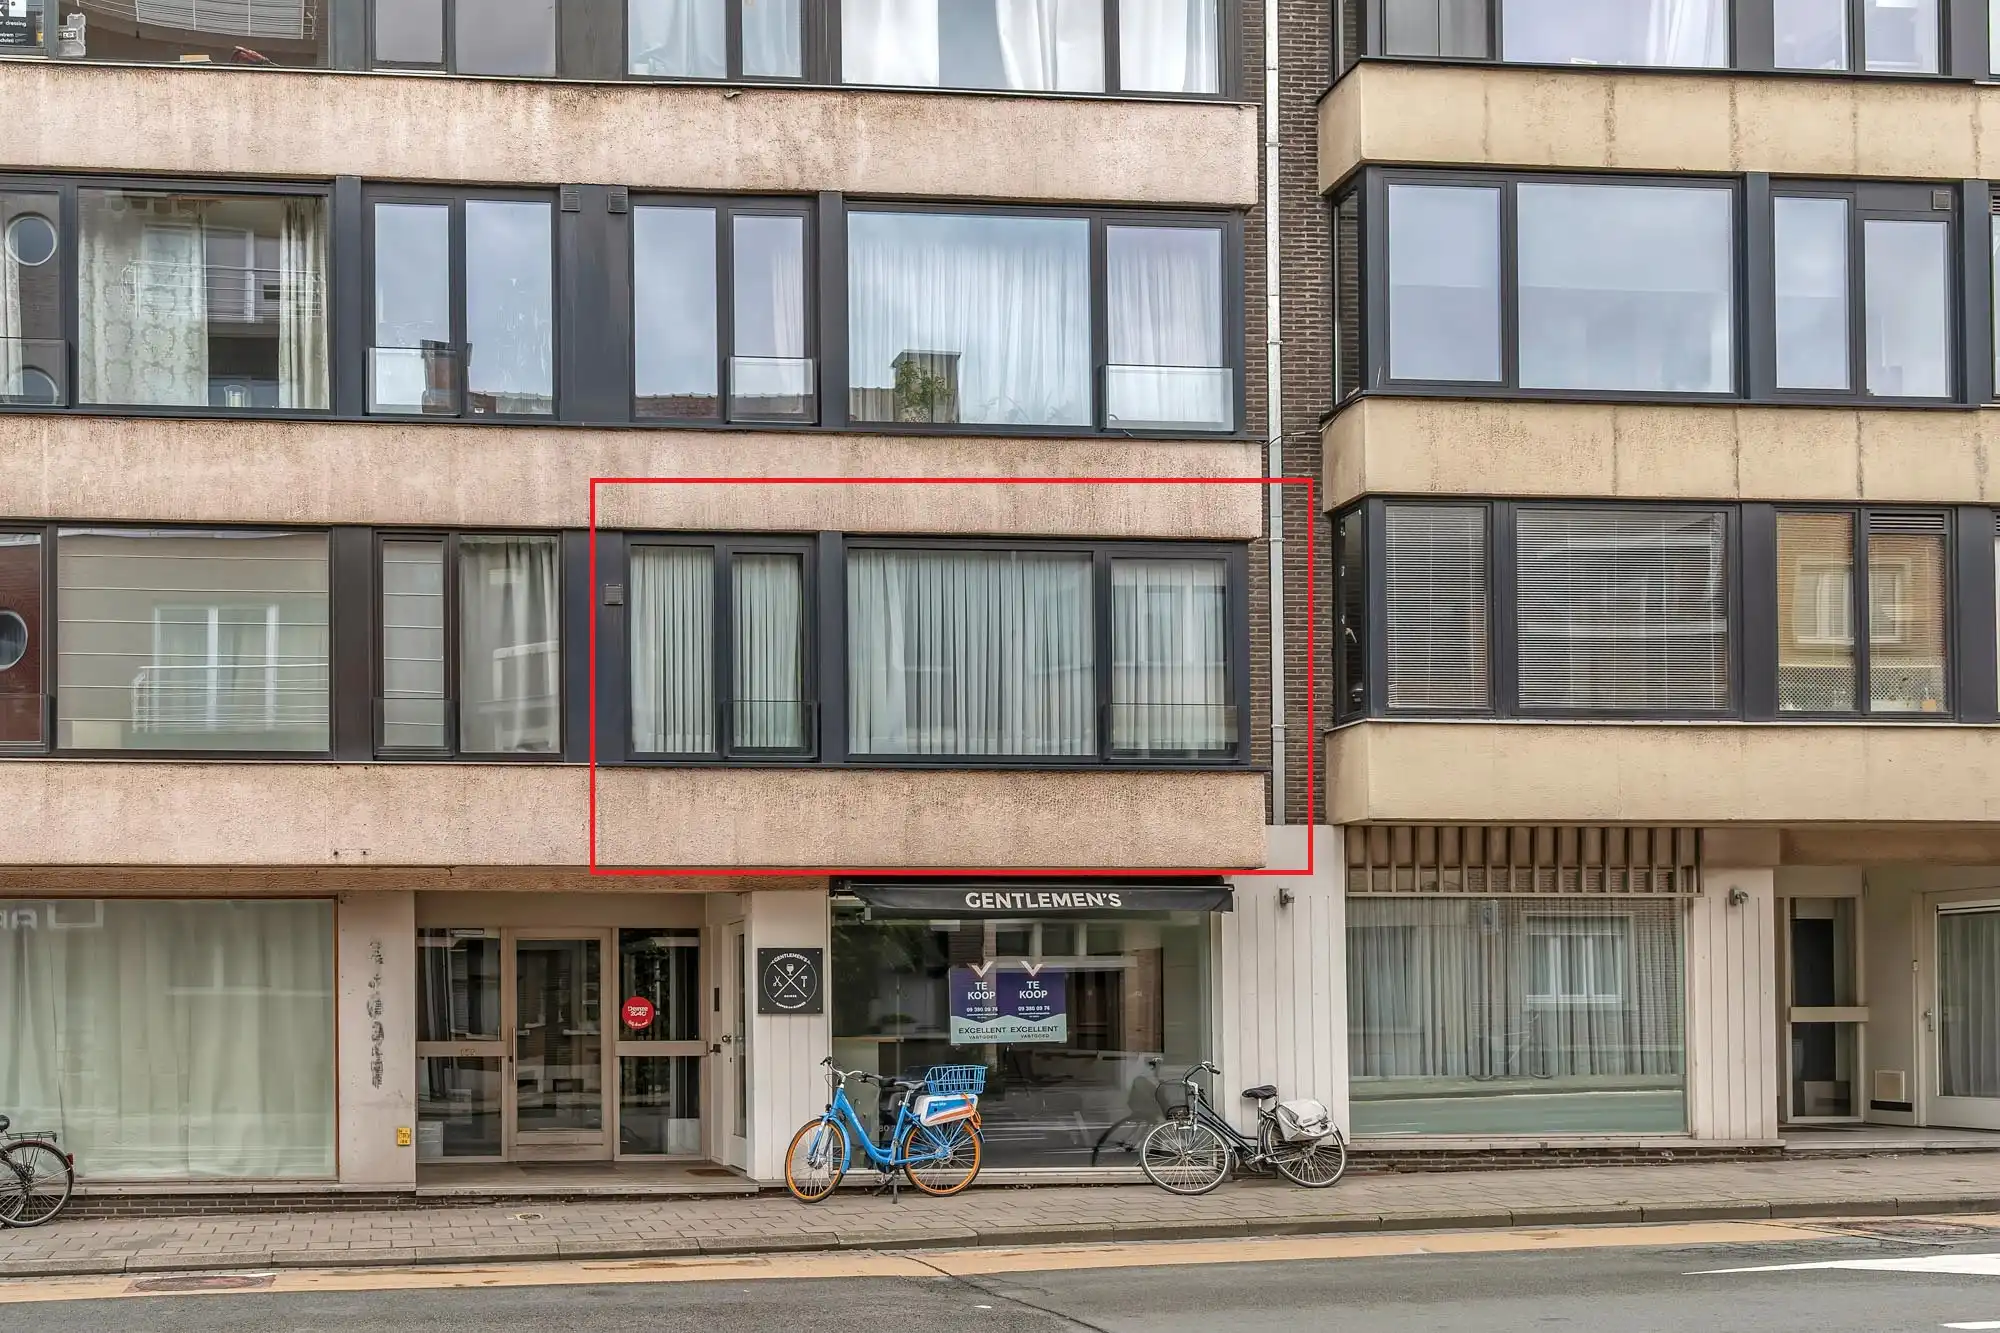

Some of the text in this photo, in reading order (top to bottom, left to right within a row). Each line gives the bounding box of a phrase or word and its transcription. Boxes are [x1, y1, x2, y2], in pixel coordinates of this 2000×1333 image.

[965, 892, 1122, 909] GENTLEMEN'S
[975, 982, 988, 990] TE
[1026, 981, 1040, 989] TE
[967, 991, 996, 1000] KOOP
[1019, 990, 1048, 999] KOOP
[958, 1026, 1007, 1034] EXCELLENT
[1010, 1025, 1059, 1033] EXCELLENT
